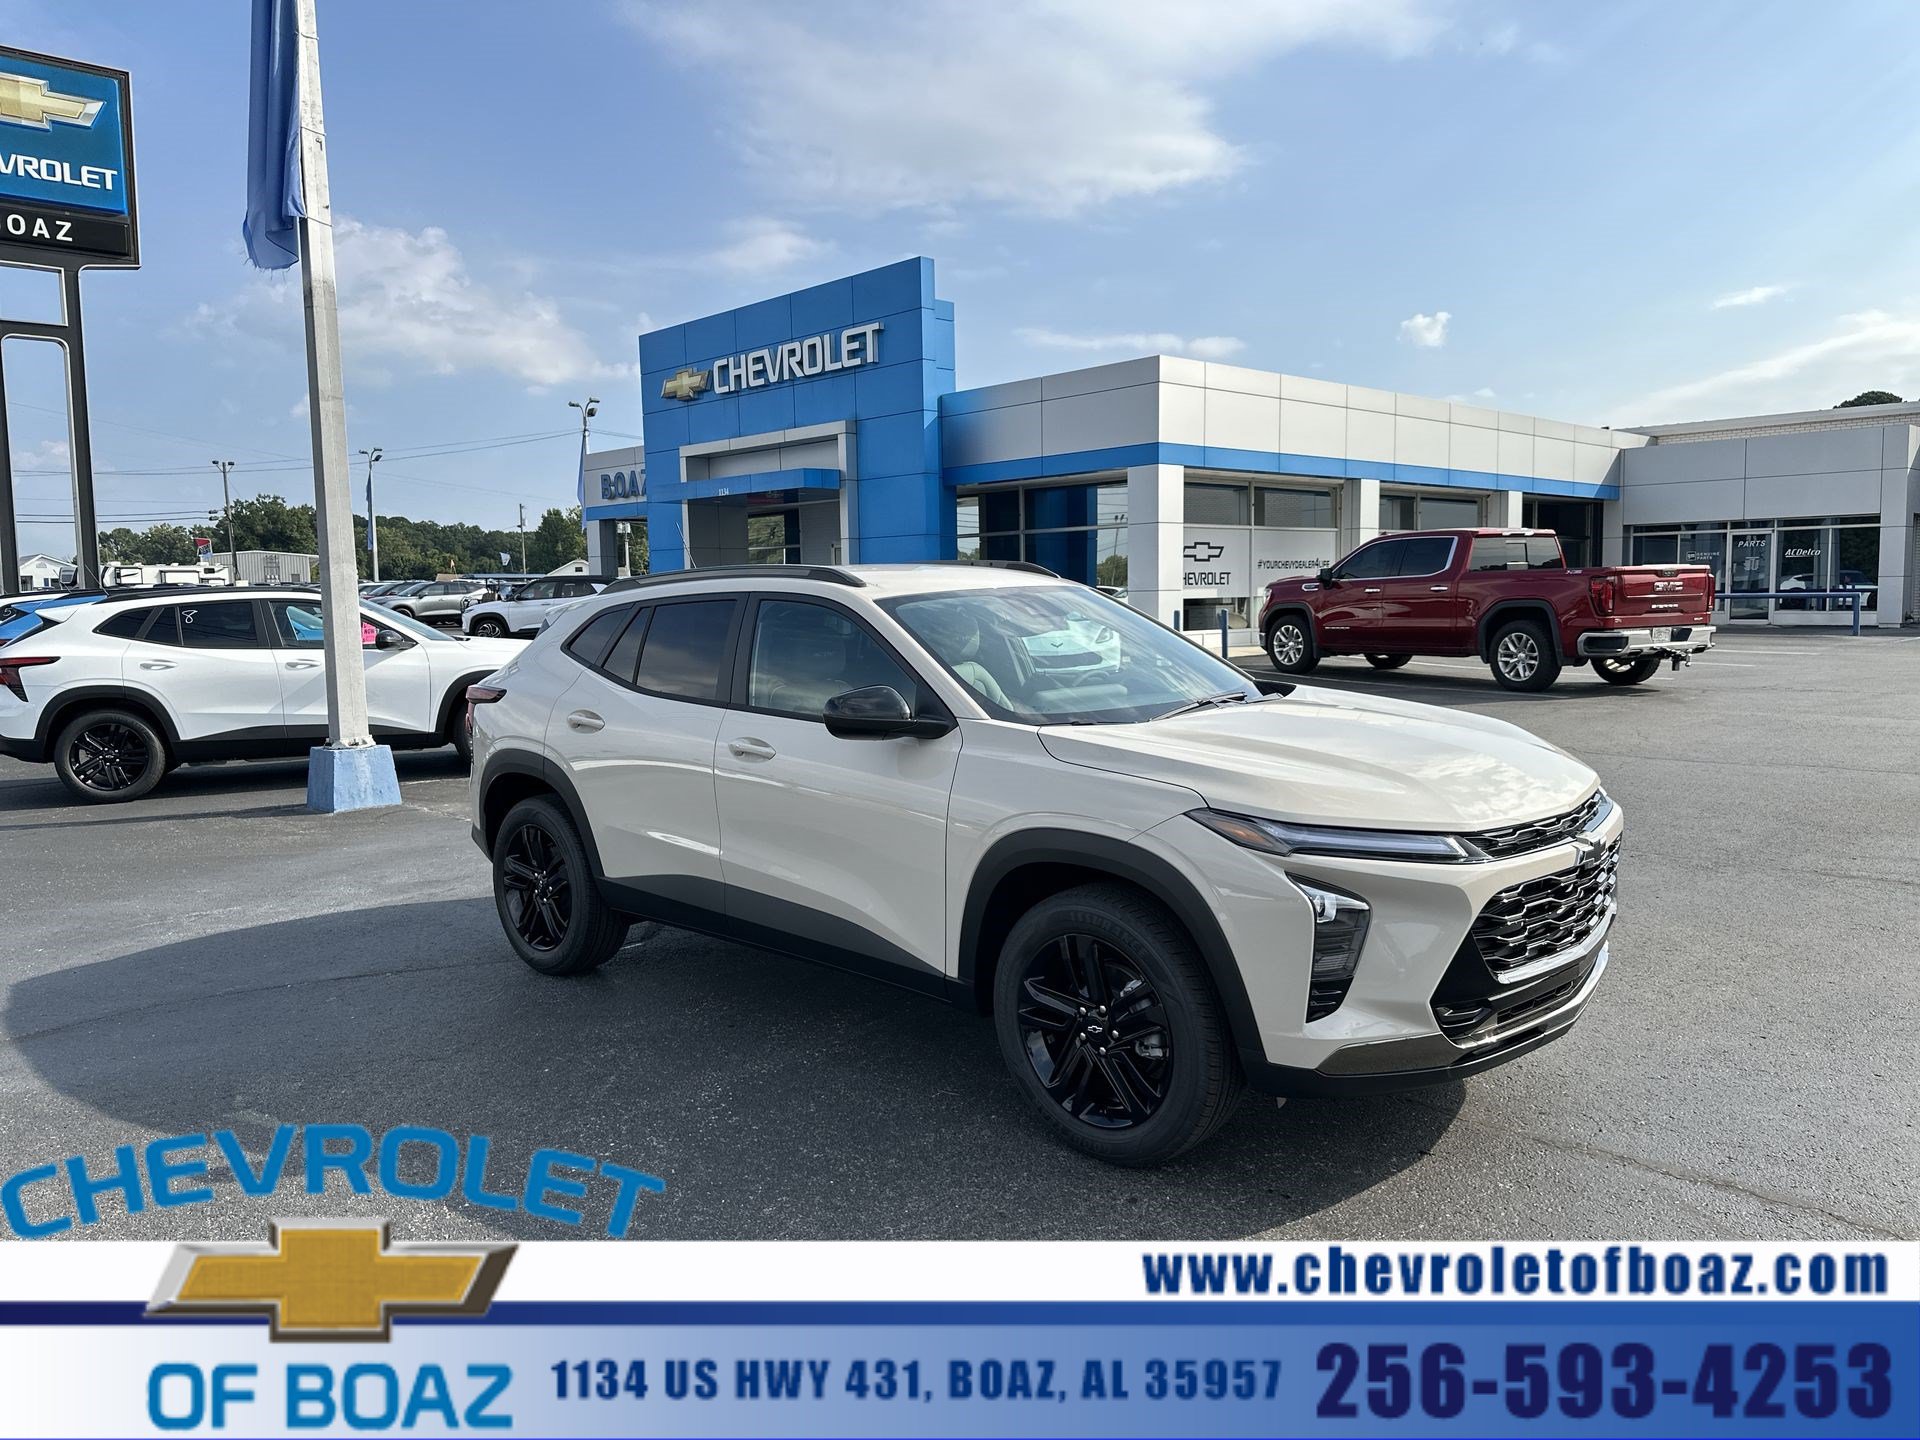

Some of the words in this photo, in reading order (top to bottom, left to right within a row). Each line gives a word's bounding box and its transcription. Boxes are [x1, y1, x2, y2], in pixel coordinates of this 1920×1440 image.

[0, 153, 118, 191] VROLET
[0, 213, 73, 242] OAZ
[712, 321, 884, 395] CHEVROLET
[718, 487, 729, 496] 1134
[1738, 540, 1766, 548] PARTS
[1784, 548, 1821, 557] ACDelco
[1182, 571, 1231, 586] HEVROLET
[1653, 581, 1684, 592] GMC
[181, 609, 198, 624] 8
